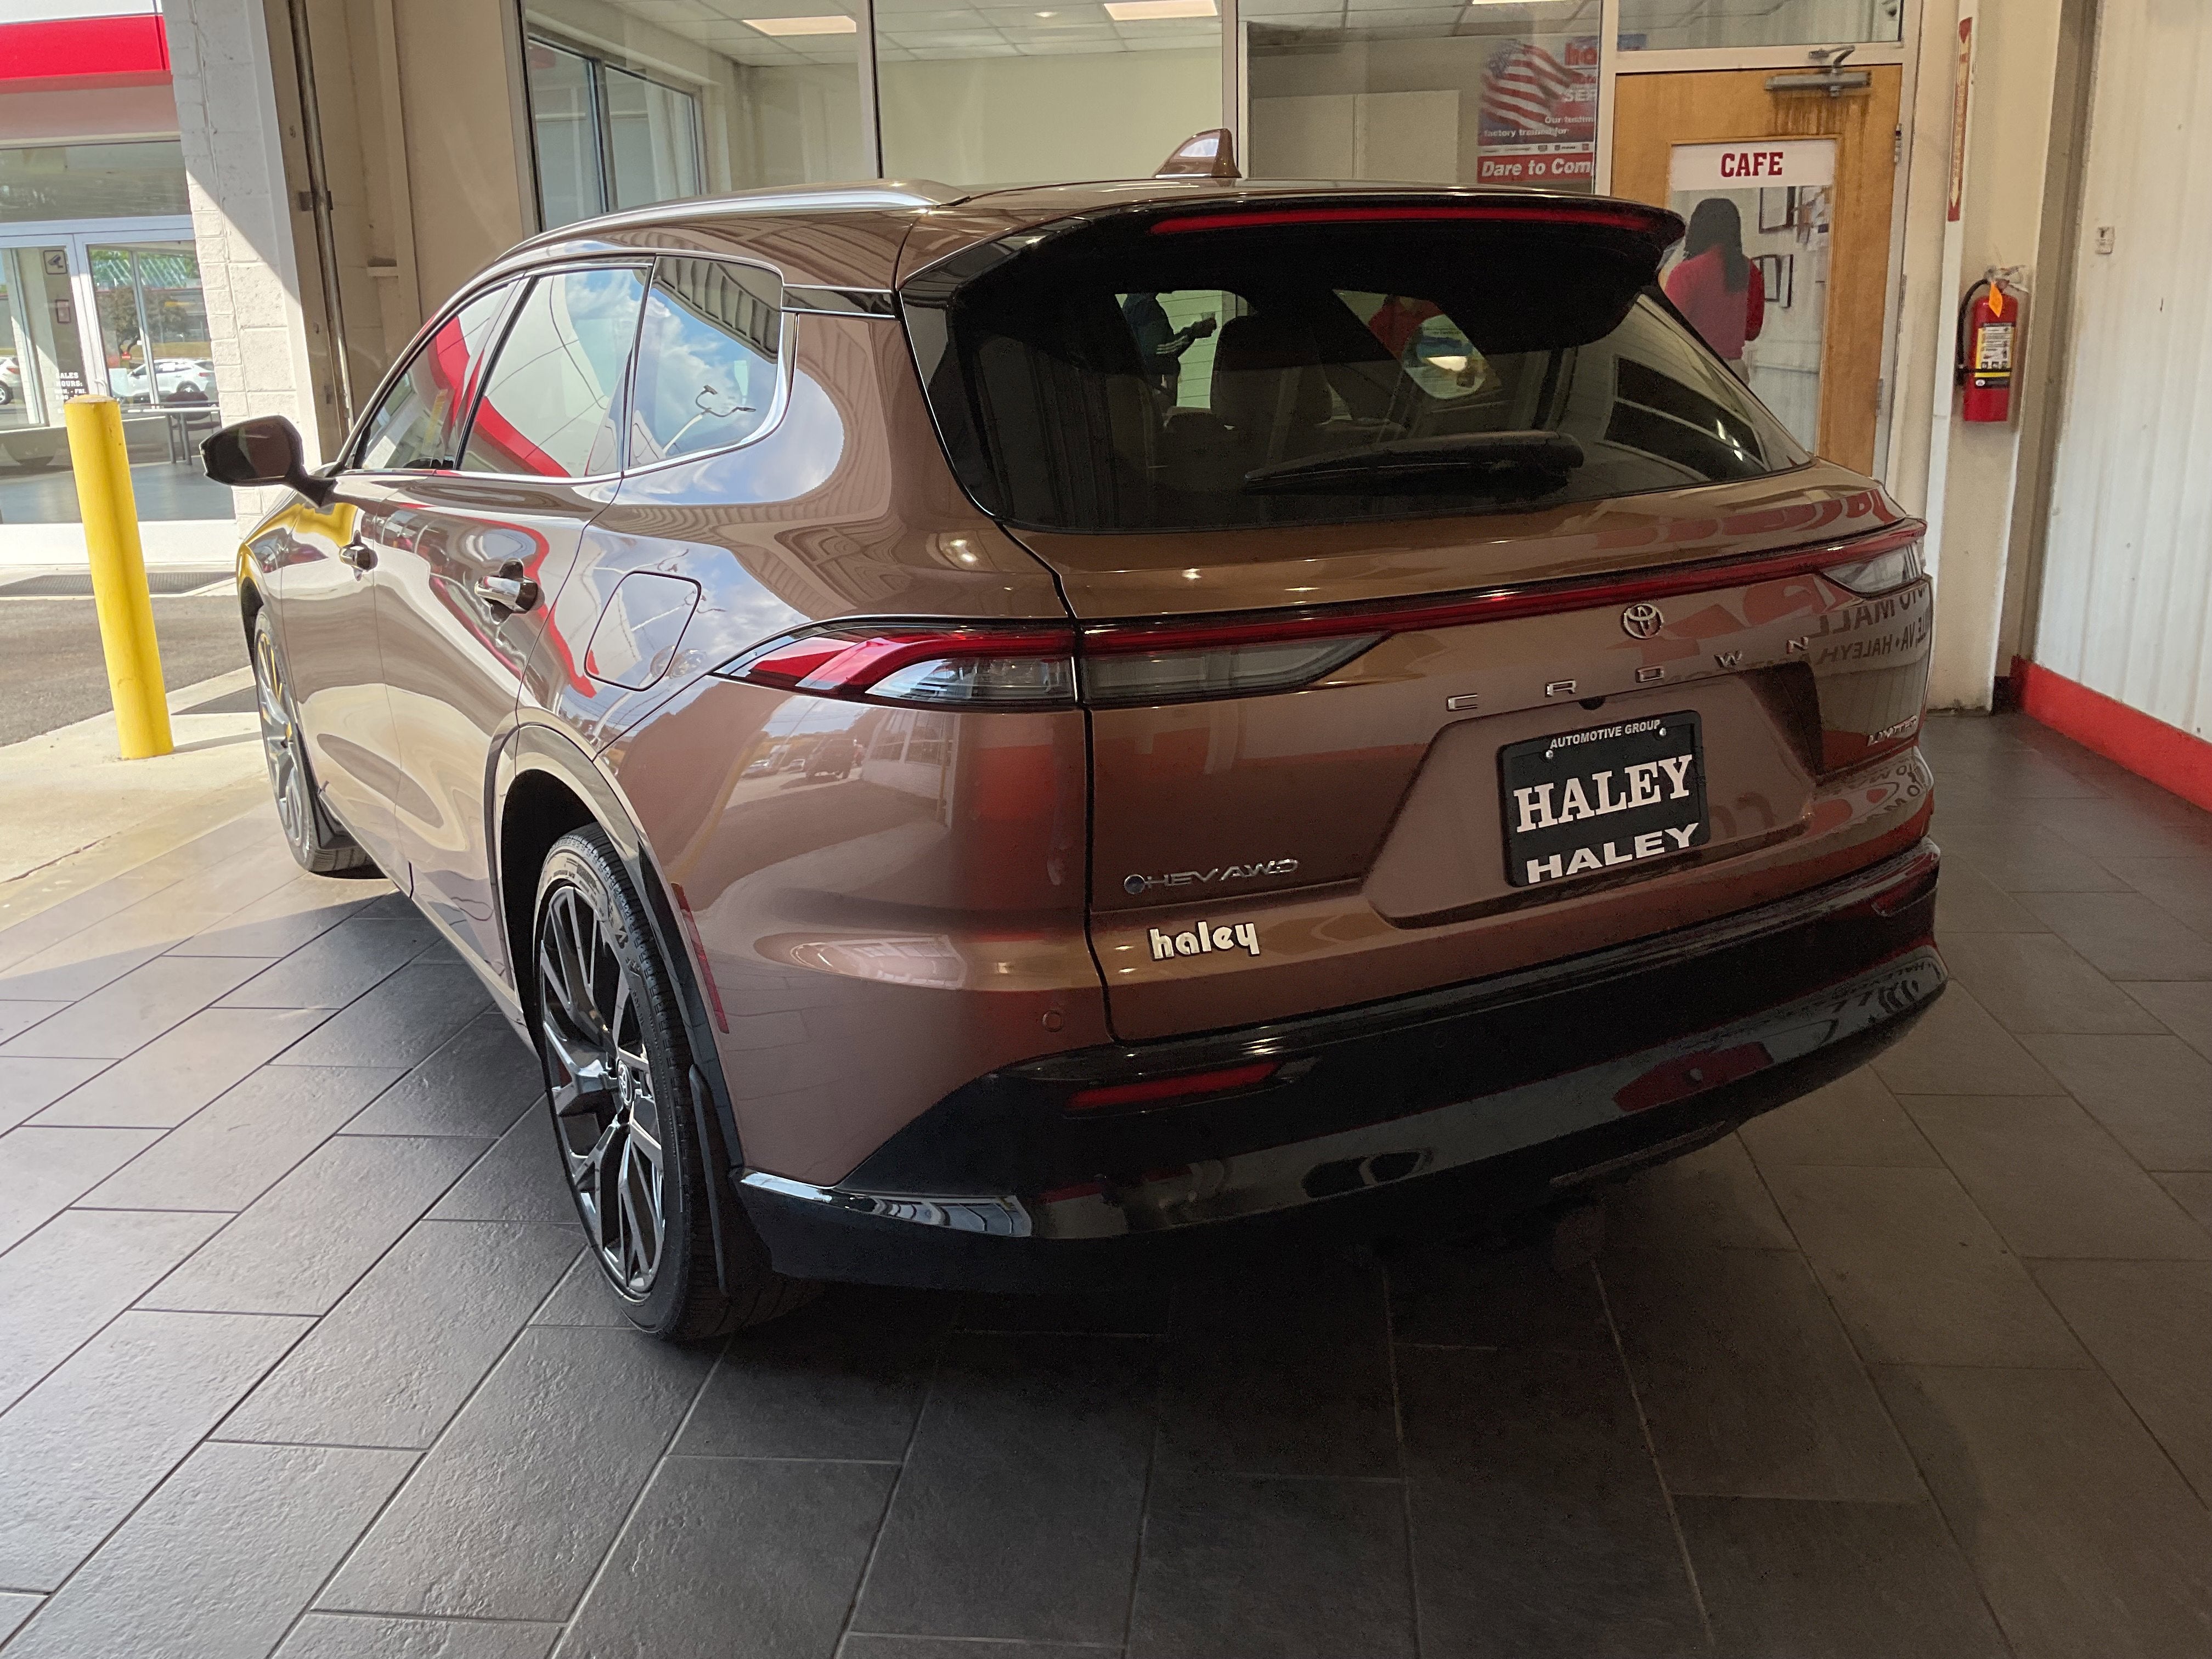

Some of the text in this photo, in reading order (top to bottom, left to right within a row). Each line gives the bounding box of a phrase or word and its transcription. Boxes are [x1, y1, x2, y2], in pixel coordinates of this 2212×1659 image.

[1482, 161, 1522, 177] Dare
[1528, 160, 1546, 175] to
[1721, 152, 1784, 178] CAFE
[1446, 636, 1809, 712] CROWN
[1549, 719, 1661, 750] AUTOMOTIVE GROUP
[1513, 754, 1692, 833] HALEY
[1526, 822, 1699, 884] HALEY
[1149, 921, 1260, 960] haley
